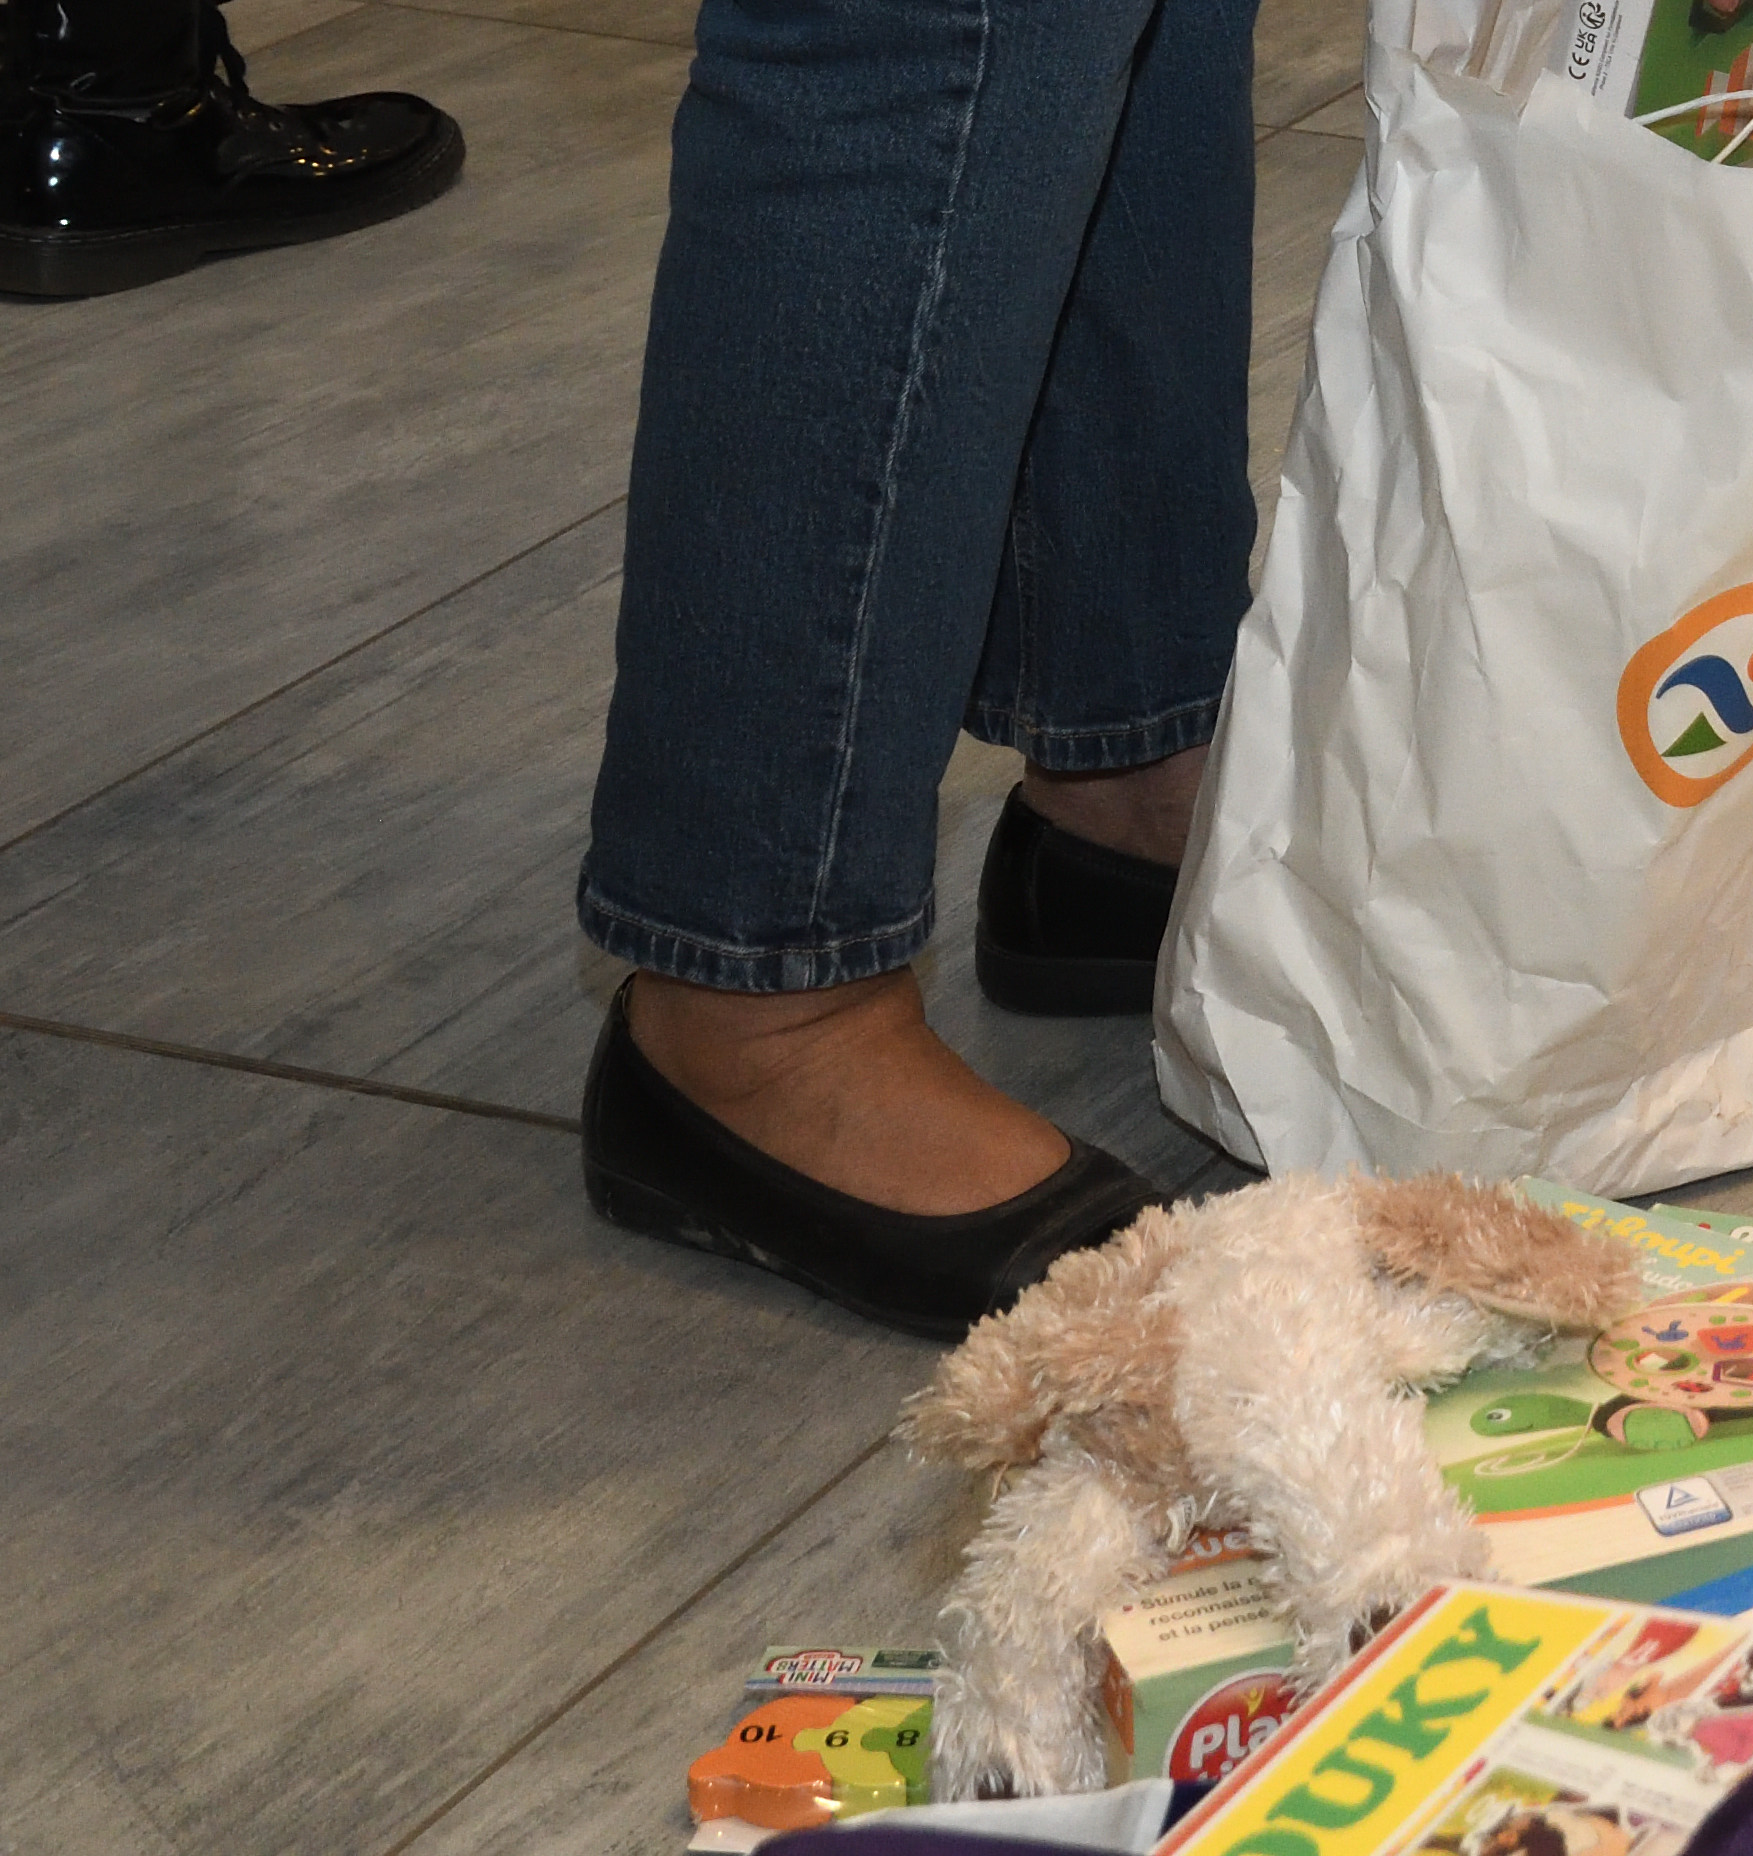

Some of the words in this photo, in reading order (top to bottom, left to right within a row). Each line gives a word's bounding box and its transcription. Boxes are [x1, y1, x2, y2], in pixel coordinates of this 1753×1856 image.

[1574, 30, 1588, 49] UK
[1584, 32, 1598, 54] CA
[1140, 1585, 1219, 1610] Stimule
[1222, 1578, 1242, 1593] la
[1149, 1591, 1274, 1626] reconnaiss
[1158, 1629, 1180, 1642] et
[1184, 1623, 1204, 1637] la
[1208, 1608, 1272, 1633] pensé
[776, 1658, 856, 1674] MATTERS
[788, 1671, 829, 1684] MINI
[739, 1724, 783, 1743] 10
[825, 1729, 850, 1748] 9
[896, 1729, 921, 1748] 8
